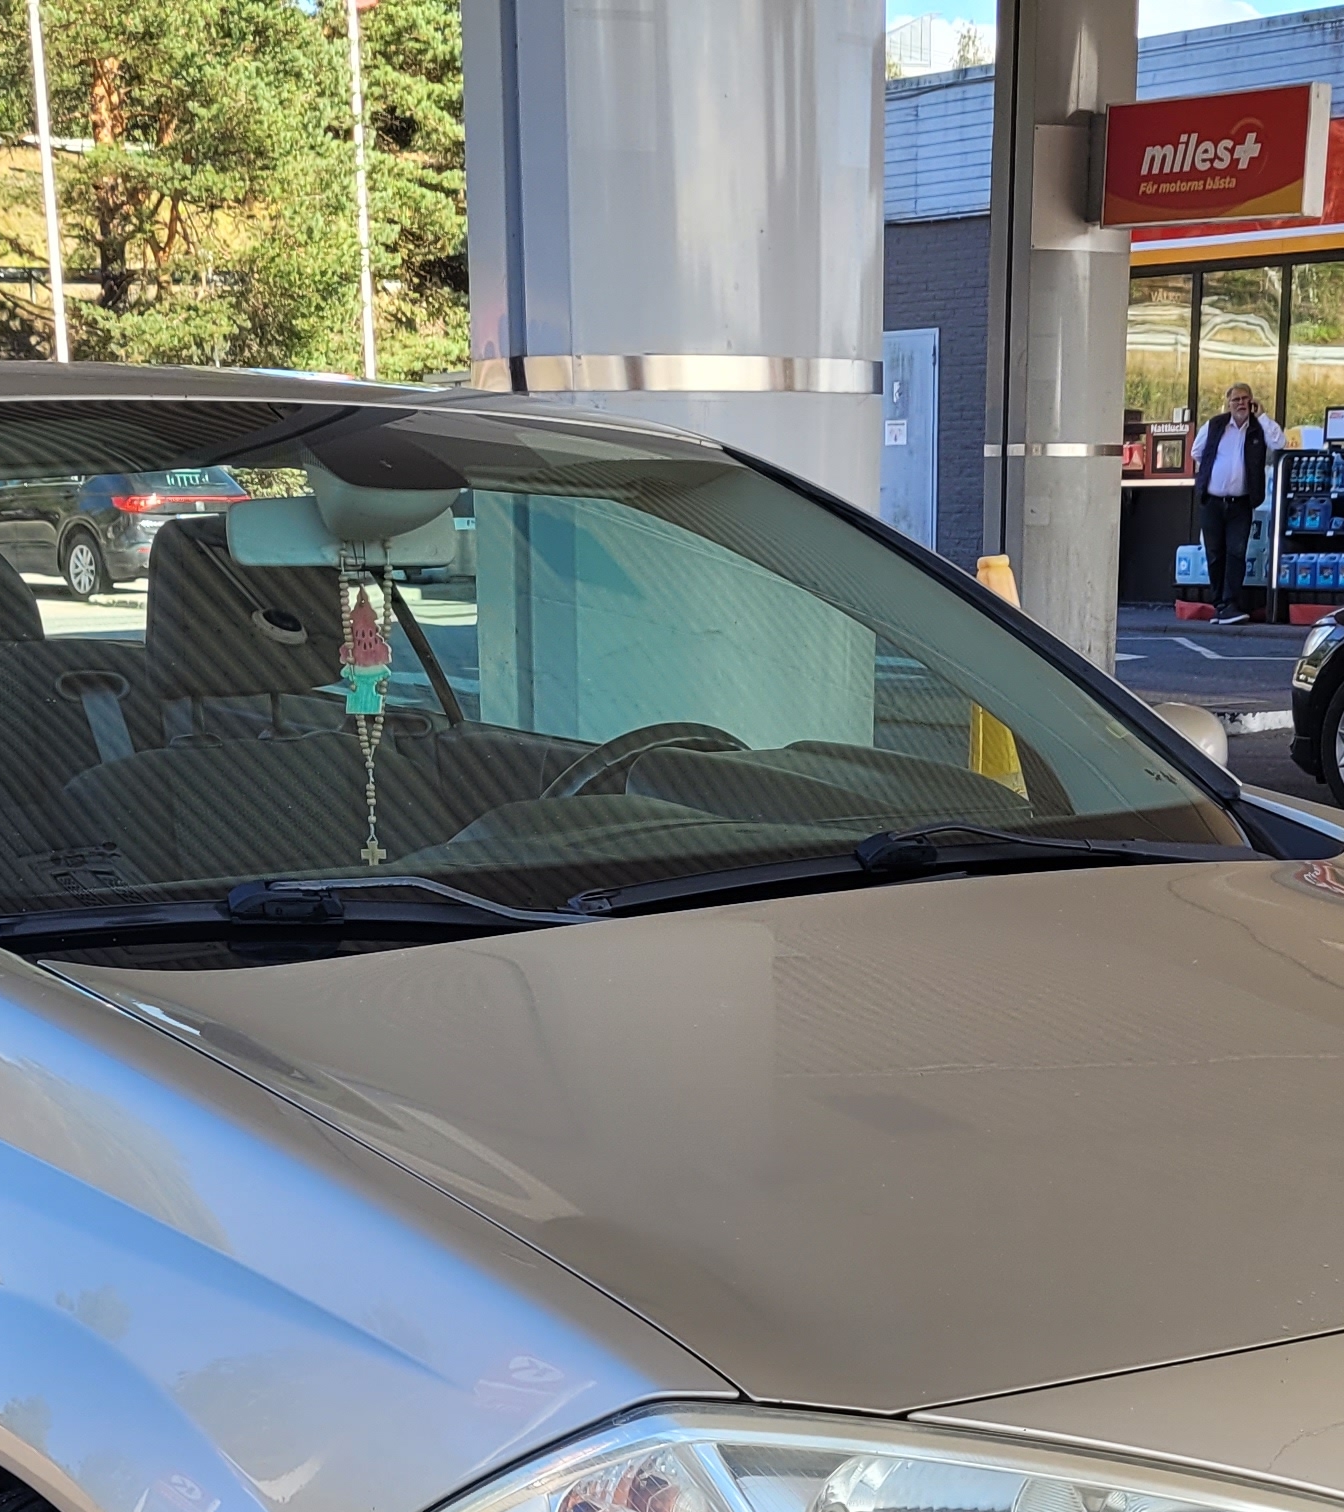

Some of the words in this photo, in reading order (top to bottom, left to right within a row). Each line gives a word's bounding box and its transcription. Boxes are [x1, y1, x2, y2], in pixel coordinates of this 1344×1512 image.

[1140, 132, 1261, 175] miles+
[1139, 182, 1157, 196] För
[1159, 180, 1203, 194] motorns
[1206, 175, 1236, 190] bästa
